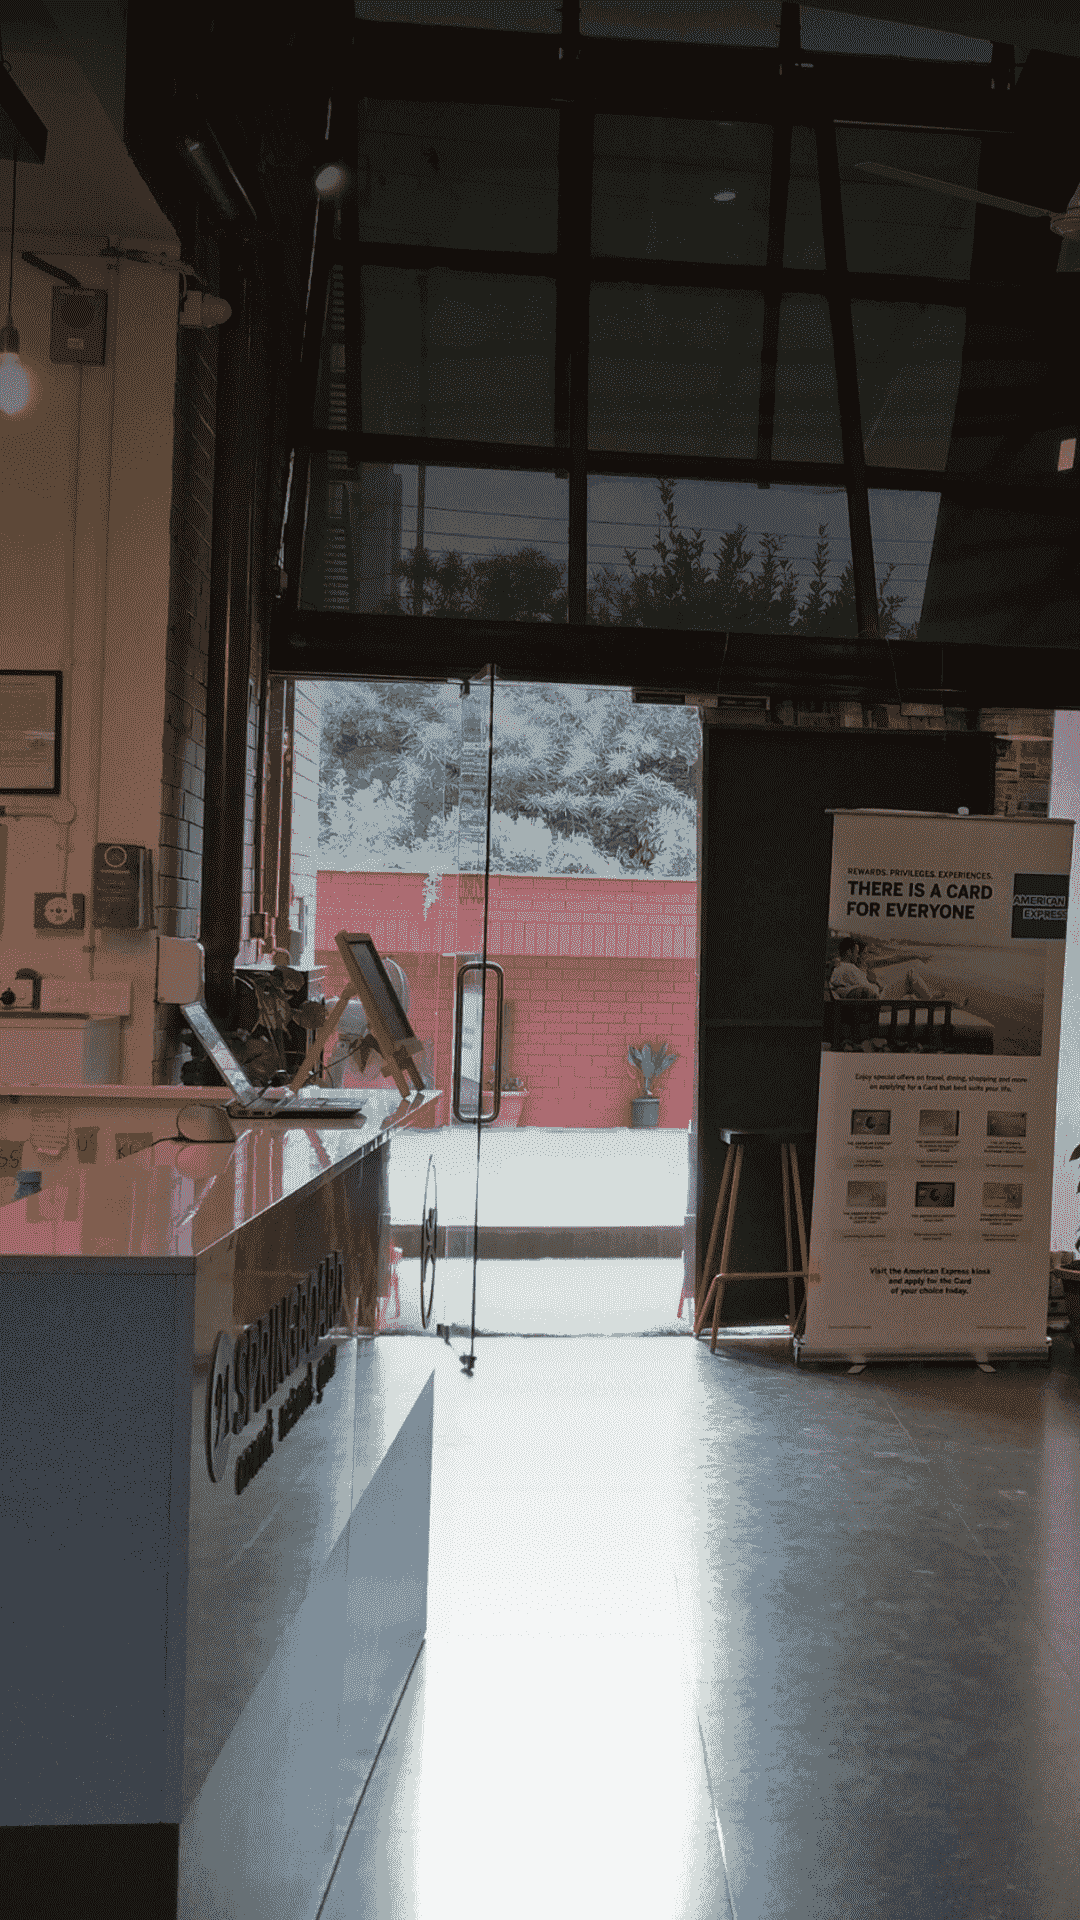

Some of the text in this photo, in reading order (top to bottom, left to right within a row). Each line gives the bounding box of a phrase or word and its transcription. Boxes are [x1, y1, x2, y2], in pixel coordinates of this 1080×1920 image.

[847, 868, 993, 880] REWARDS. PRIVILEGES. EXPERIENCES.
[848, 881, 993, 899] THERE IS A CARD
[1013, 895, 1066, 906] AMERICAN
[847, 901, 975, 919] FOR EVERYONE
[869, 1267, 888, 1275] Visit
[940, 1267, 970, 1275] Express
[904, 1278, 924, 1286] apply
[232, 1250, 344, 1436] SPRINGBOARD
